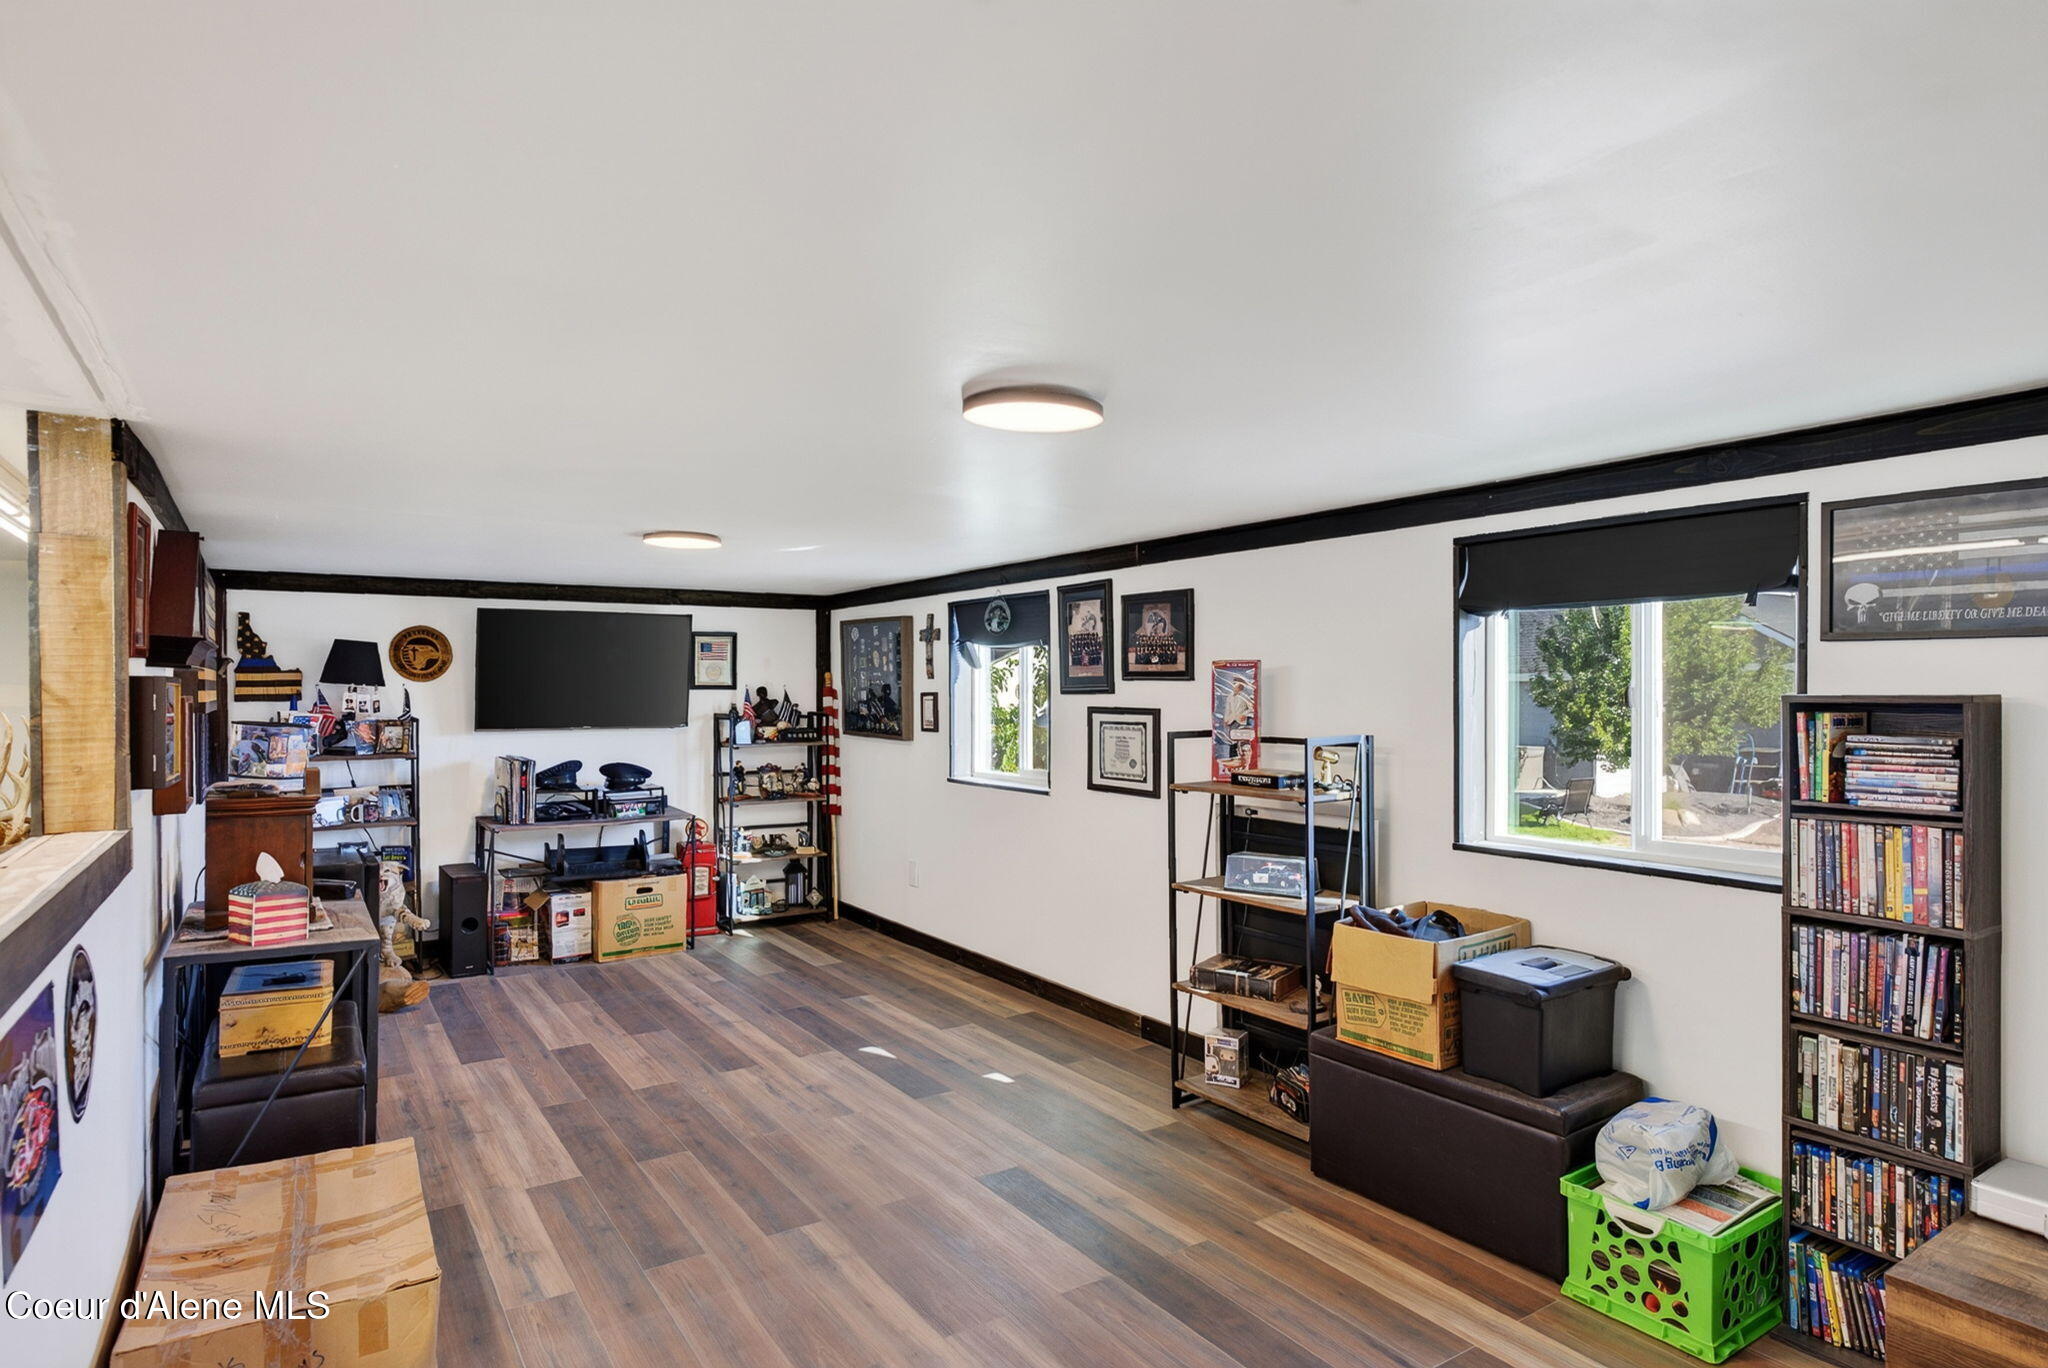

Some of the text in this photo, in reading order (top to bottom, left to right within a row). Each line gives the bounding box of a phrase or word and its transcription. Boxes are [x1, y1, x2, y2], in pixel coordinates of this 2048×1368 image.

[1906, 610, 1921, 622] ME
[1922, 608, 1963, 622] LIBERTY
[1964, 607, 1979, 620] OR
[1980, 606, 2005, 619] GIVE
[2006, 605, 2024, 618] ME
[2025, 604, 2048, 617] DEA
